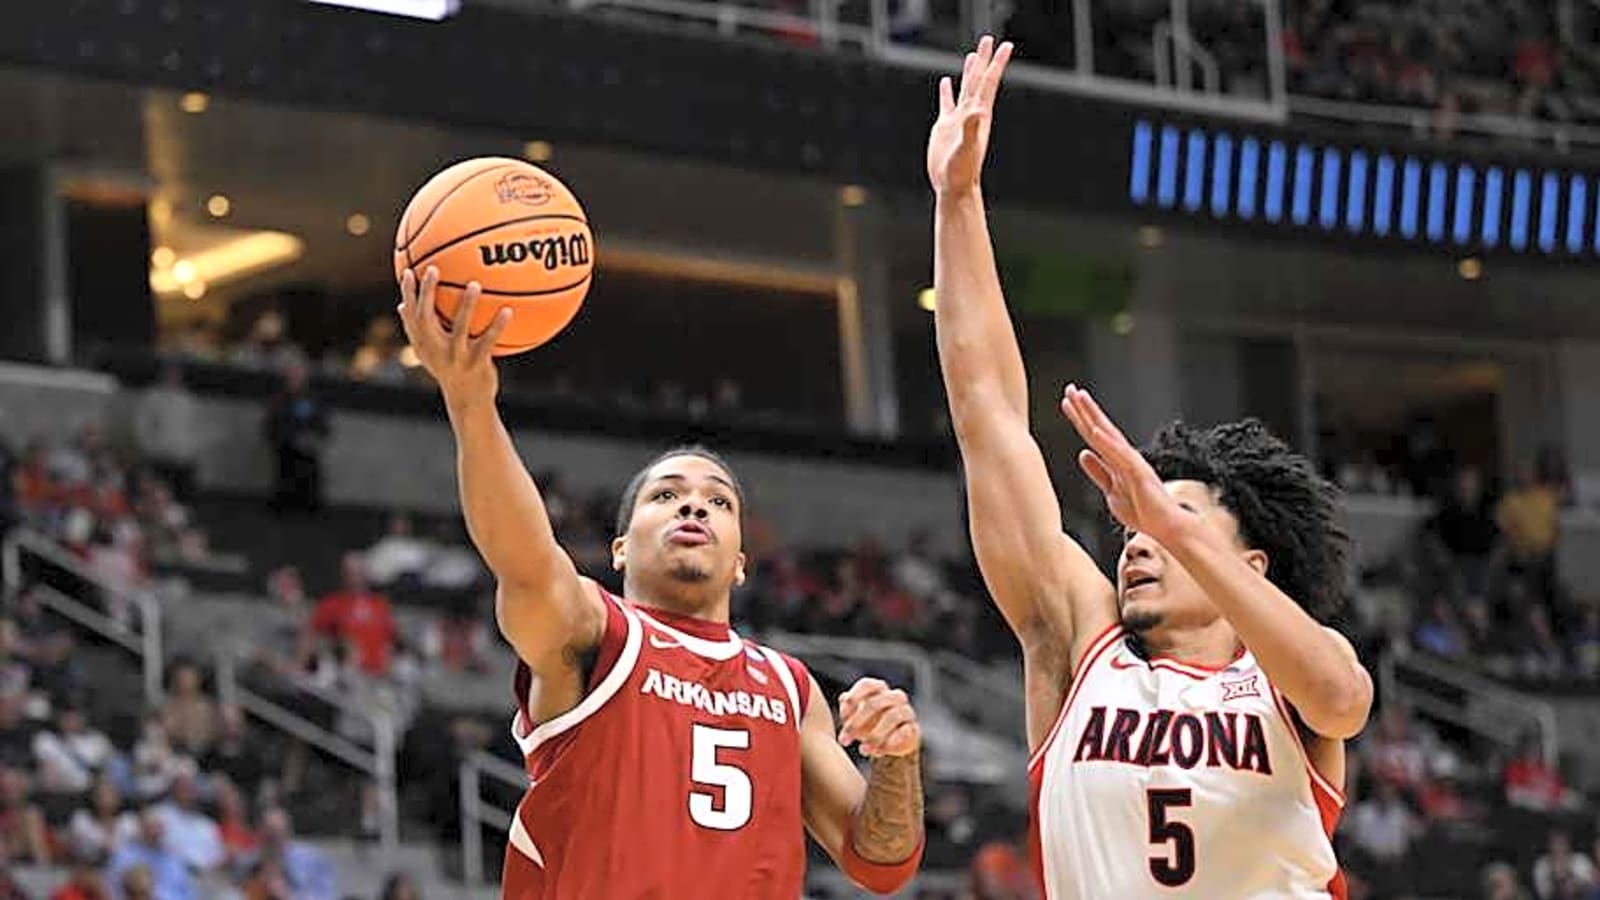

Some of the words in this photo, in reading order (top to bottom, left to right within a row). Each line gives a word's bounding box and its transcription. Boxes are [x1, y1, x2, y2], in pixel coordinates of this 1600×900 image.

[479, 232, 589, 270] Wilson
[640, 667, 787, 725] ARKANSAS
[1073, 705, 1273, 776] ARIZONA
[688, 722, 754, 831] 5
[1146, 788, 1196, 888] 5
